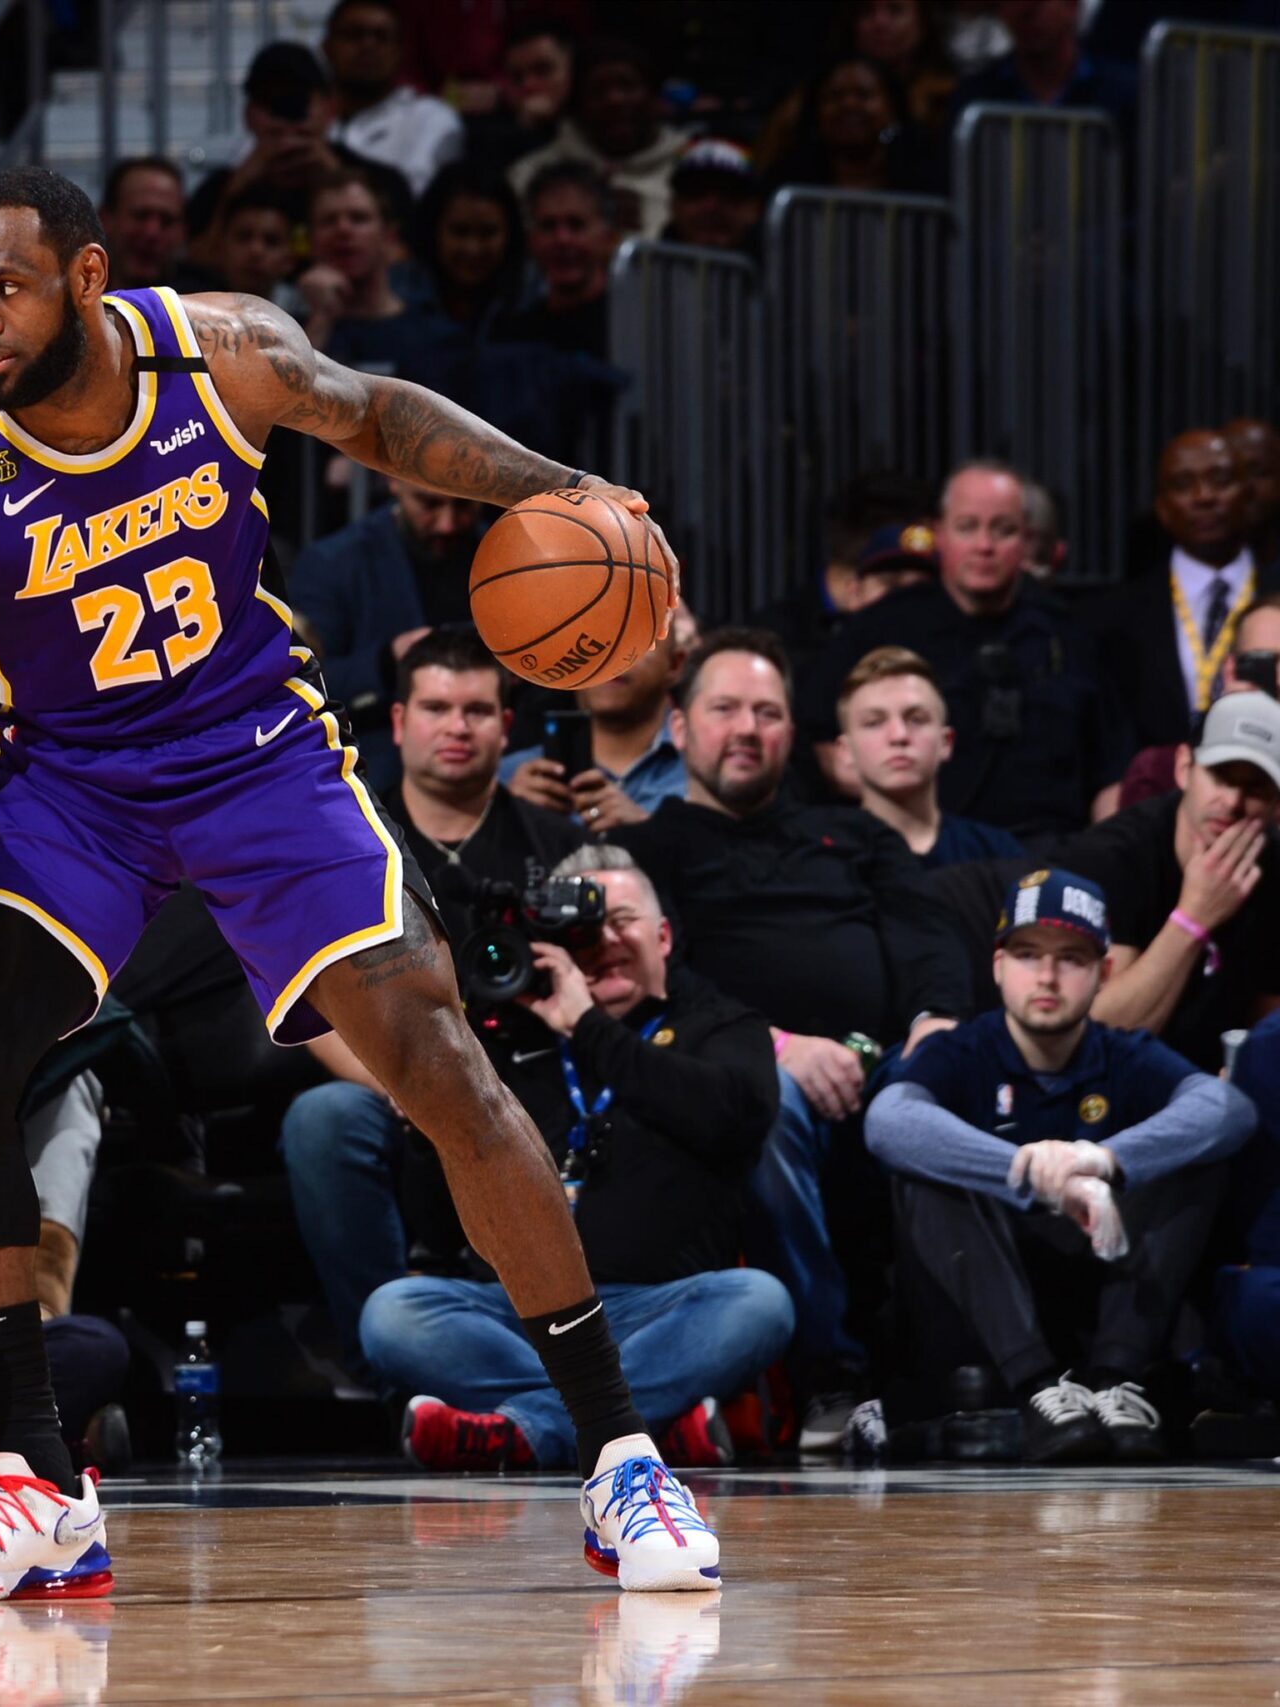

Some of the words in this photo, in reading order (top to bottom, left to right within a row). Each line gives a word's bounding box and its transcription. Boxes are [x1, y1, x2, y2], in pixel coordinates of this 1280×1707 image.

[150, 419, 205, 455] wish
[14, 462, 229, 600] LAKERS
[71, 556, 223, 691] 23
